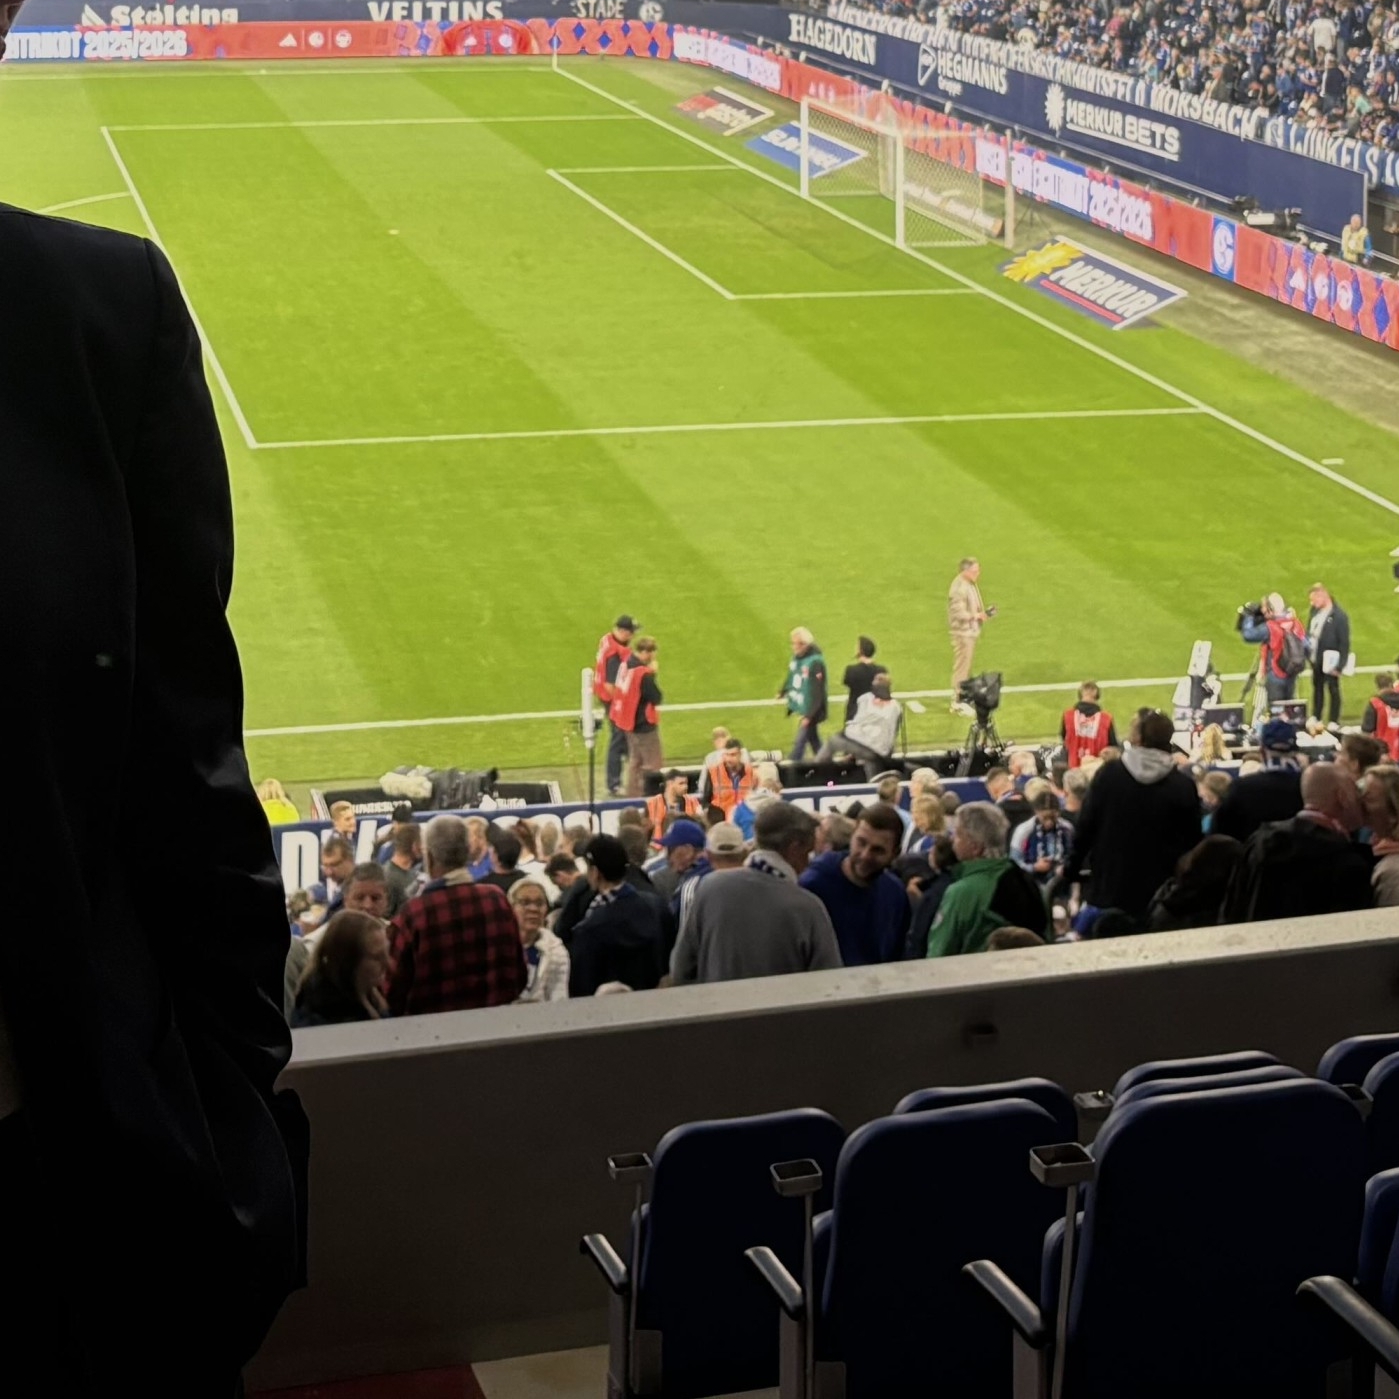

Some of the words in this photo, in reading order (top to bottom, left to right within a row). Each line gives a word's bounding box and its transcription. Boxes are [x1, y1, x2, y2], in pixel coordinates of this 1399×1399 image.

[83, 29, 188, 59] 2025/2026
[788, 13, 877, 67] HAGEDORN
[938, 49, 1007, 95] HEGMANNS
[1065, 98, 1122, 139] MERKUR
[1123, 114, 1181, 154] BETS
[1048, 260, 1159, 319] MERKUR
